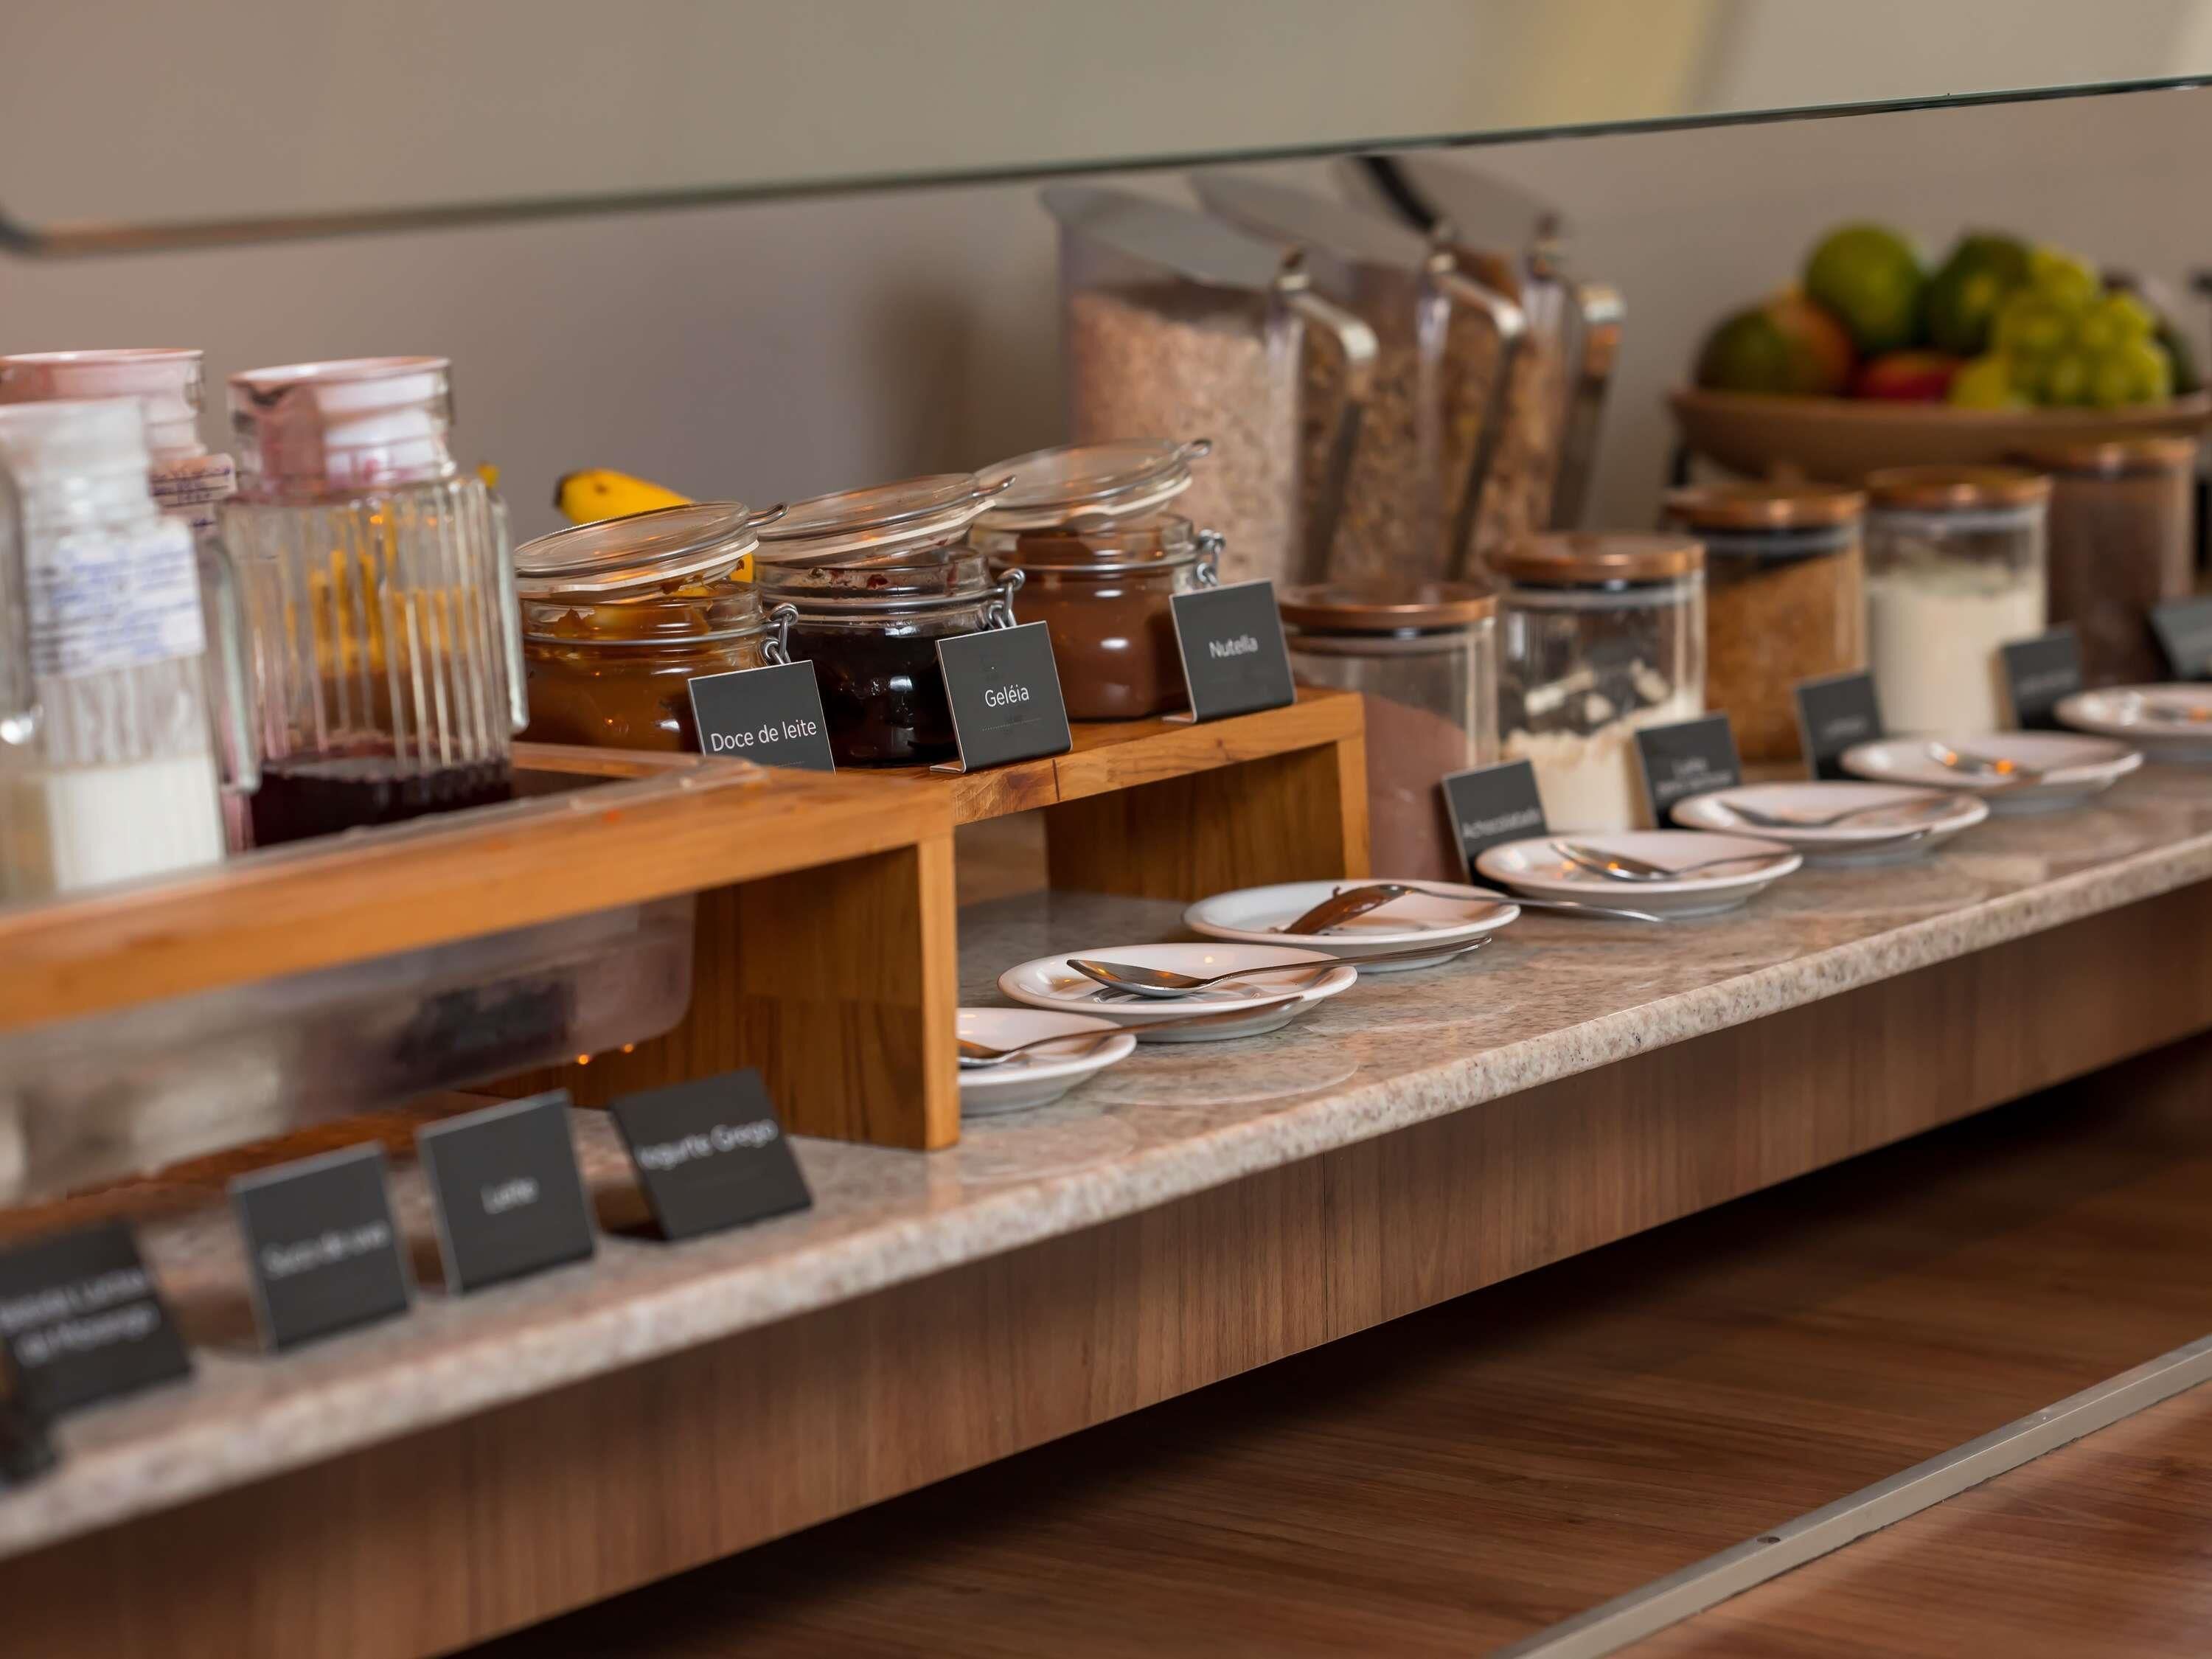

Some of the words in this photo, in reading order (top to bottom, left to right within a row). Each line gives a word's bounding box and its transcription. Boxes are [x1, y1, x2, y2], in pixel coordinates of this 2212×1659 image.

[1209, 634, 1259, 658] Nutella
[984, 684, 1030, 707] Geléia
[710, 732, 754, 751] Doce
[758, 724, 779, 744] de
[782, 719, 817, 740] leite
[711, 1119, 779, 1152] Grego
